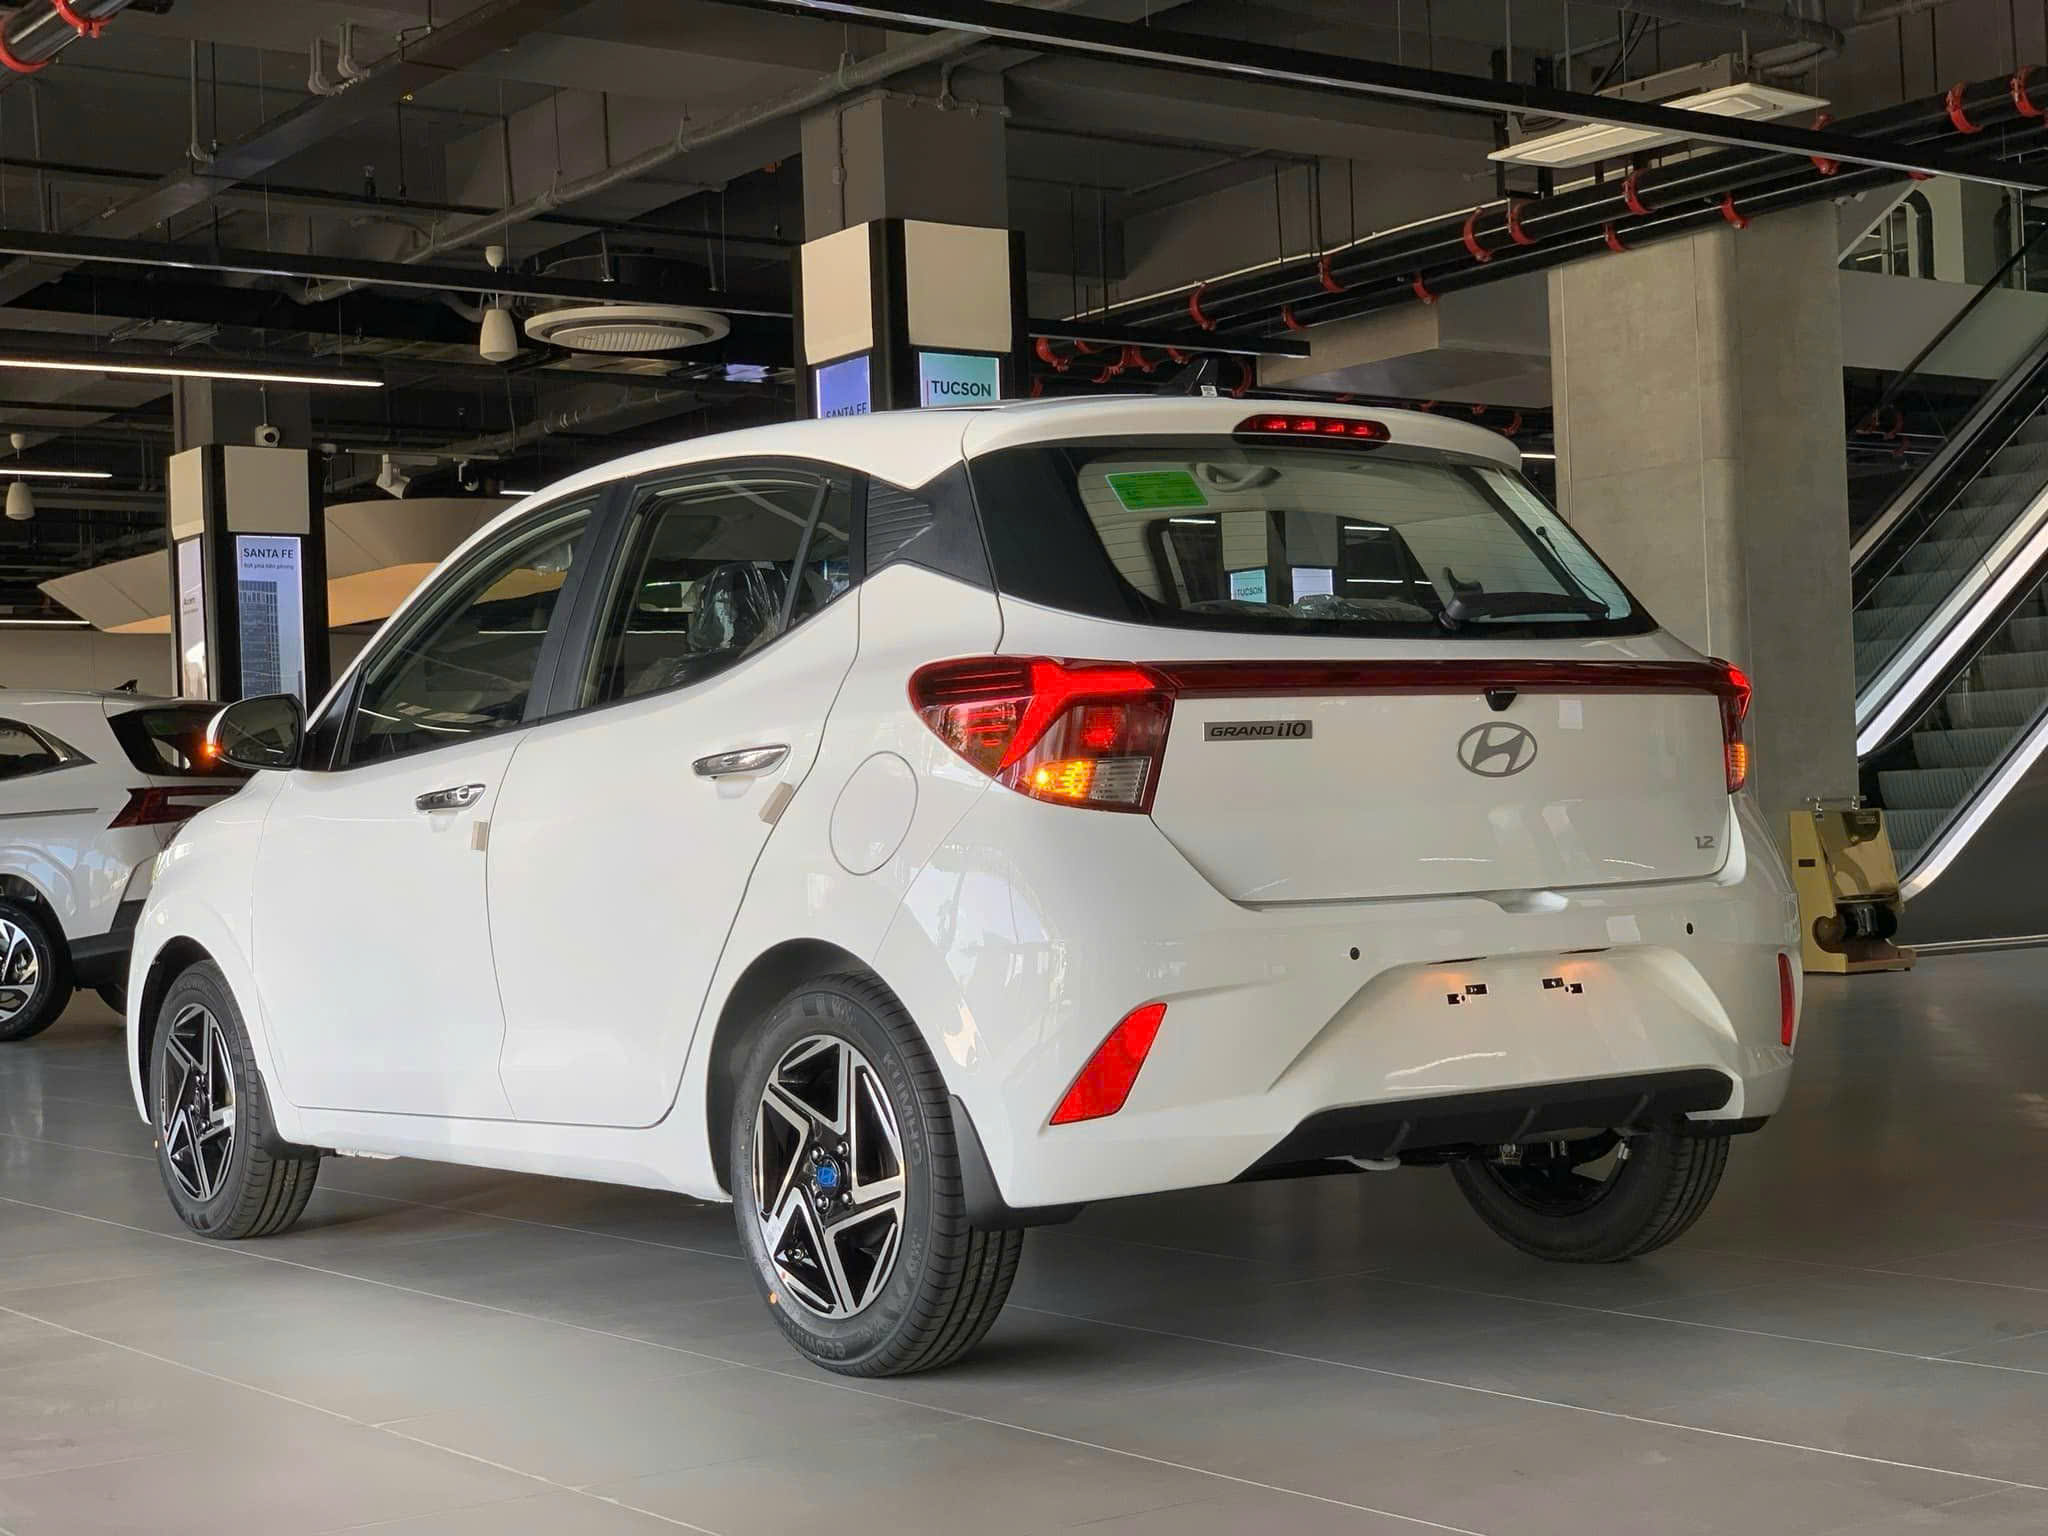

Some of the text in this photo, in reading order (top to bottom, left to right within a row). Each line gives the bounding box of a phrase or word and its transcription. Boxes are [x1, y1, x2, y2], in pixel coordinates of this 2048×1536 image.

[932, 380, 992, 397] TUCSON
[243, 547, 294, 559] SANTA FE
[1236, 586, 1263, 597] TUCSON
[1210, 722, 1307, 737] GRAND i10
[883, 1052, 922, 1167] KUMHO
